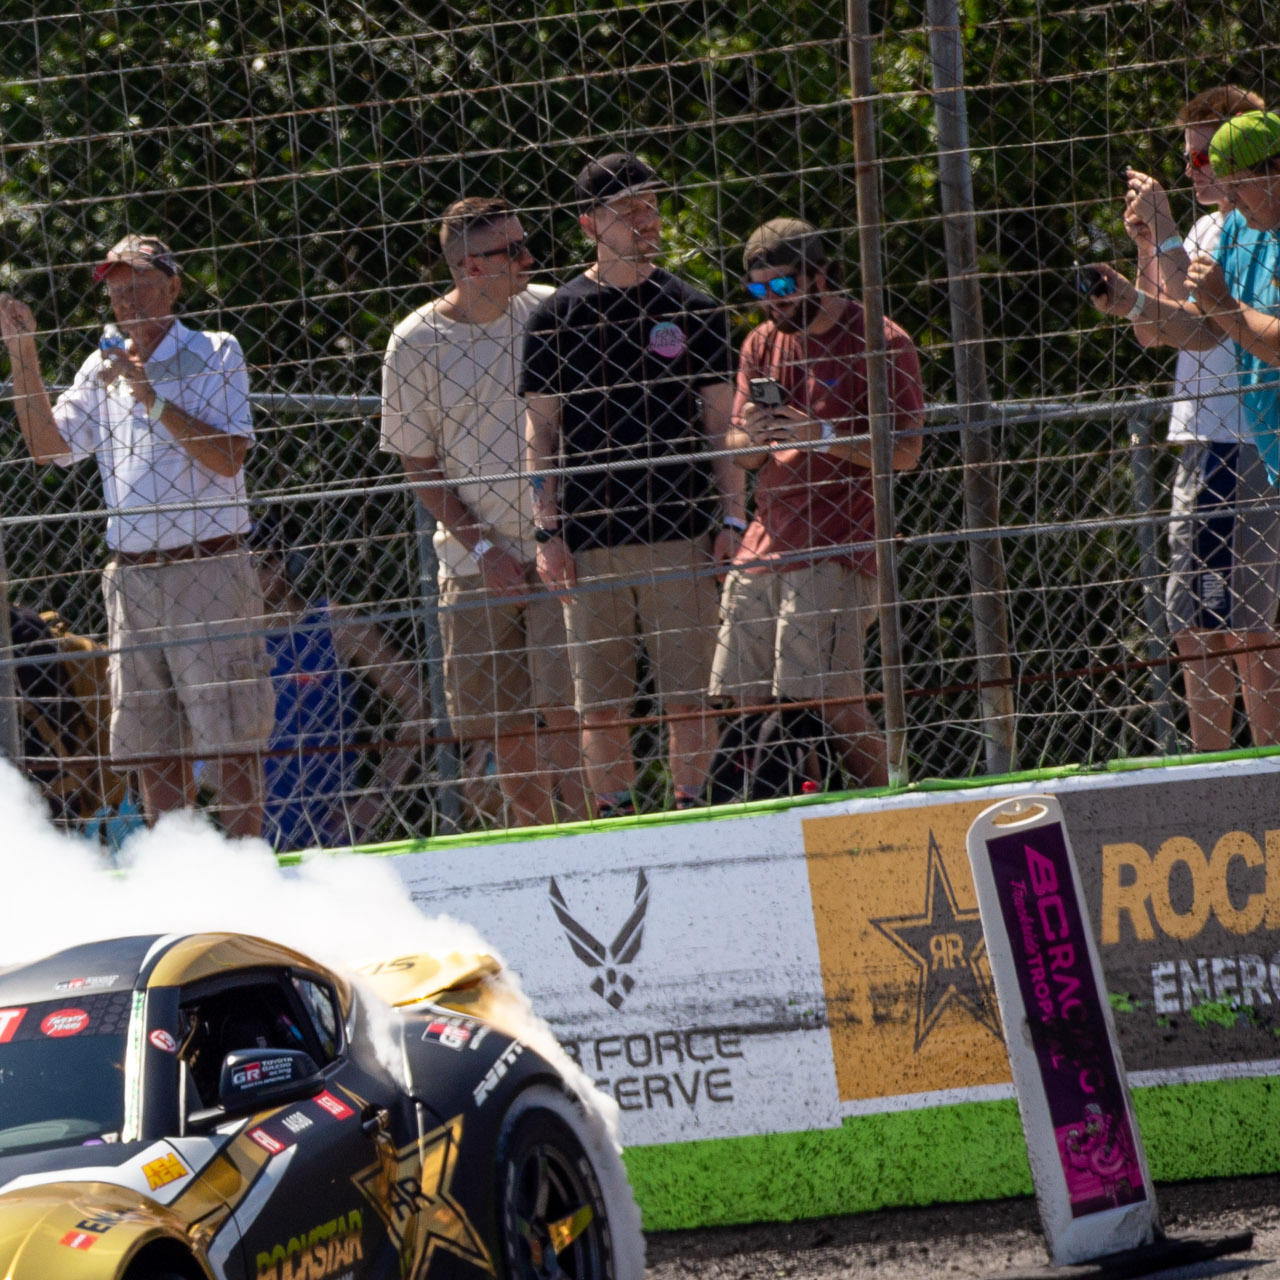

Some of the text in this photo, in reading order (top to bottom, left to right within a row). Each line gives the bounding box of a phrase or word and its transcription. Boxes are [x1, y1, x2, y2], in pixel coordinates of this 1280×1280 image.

[1101, 830, 1280, 945] ROC
[1028, 952, 1064, 1069] TROPL
[473, 1038, 525, 1107] NITT
[595, 1030, 743, 1071] FORCE
[595, 1068, 734, 1111] ERVE
